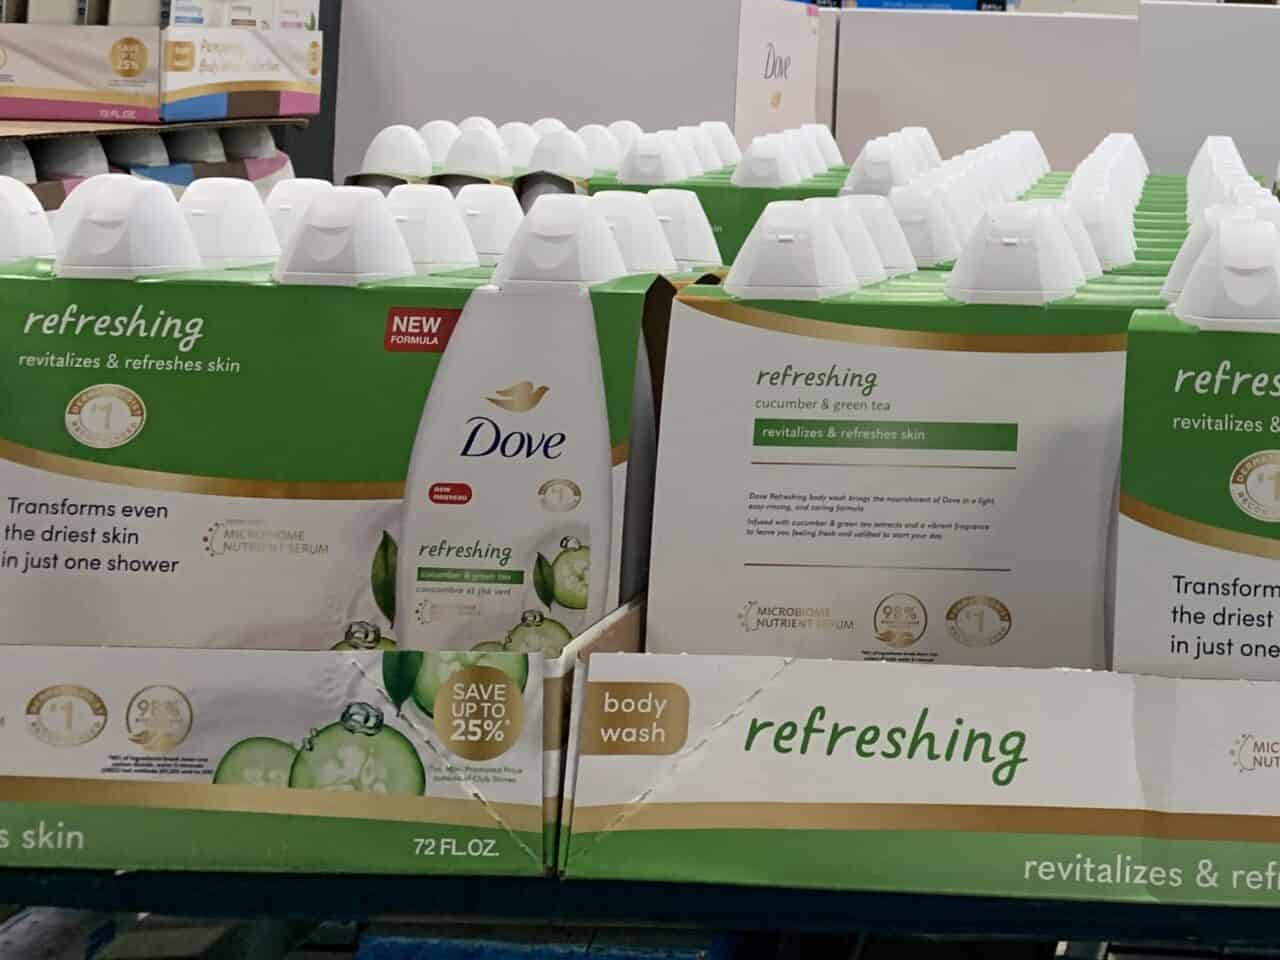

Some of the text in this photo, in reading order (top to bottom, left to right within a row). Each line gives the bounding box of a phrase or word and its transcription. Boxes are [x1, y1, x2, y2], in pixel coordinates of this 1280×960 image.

[764, 42, 791, 81] Dove
[24, 304, 204, 352] refreshing
[392, 316, 442, 334] NEW
[391, 335, 439, 345] FORMULA
[756, 364, 878, 396] refreshing
[755, 398, 890, 413] cucumber & green tea
[762, 426, 925, 441] revitalizes & refreshes skin
[1173, 415, 1263, 433] revitalizes
[460, 416, 567, 460] Dove
[418, 540, 512, 567] refreshing
[1171, 606, 1206, 625] the
[1212, 607, 1274, 628] driest
[1171, 636, 1189, 654] in
[1194, 636, 1233, 660] just
[1240, 641, 1280, 658] one
[452, 683, 507, 701] SAVE
[604, 691, 667, 716] body
[452, 703, 505, 718] UP TO
[601, 722, 665, 743] wash
[744, 705, 1028, 786] refreshing
[22, 822, 84, 850] skin
[413, 839, 435, 855] 72
[1024, 855, 1183, 888] revitalizes
[1196, 859, 1221, 888] &
